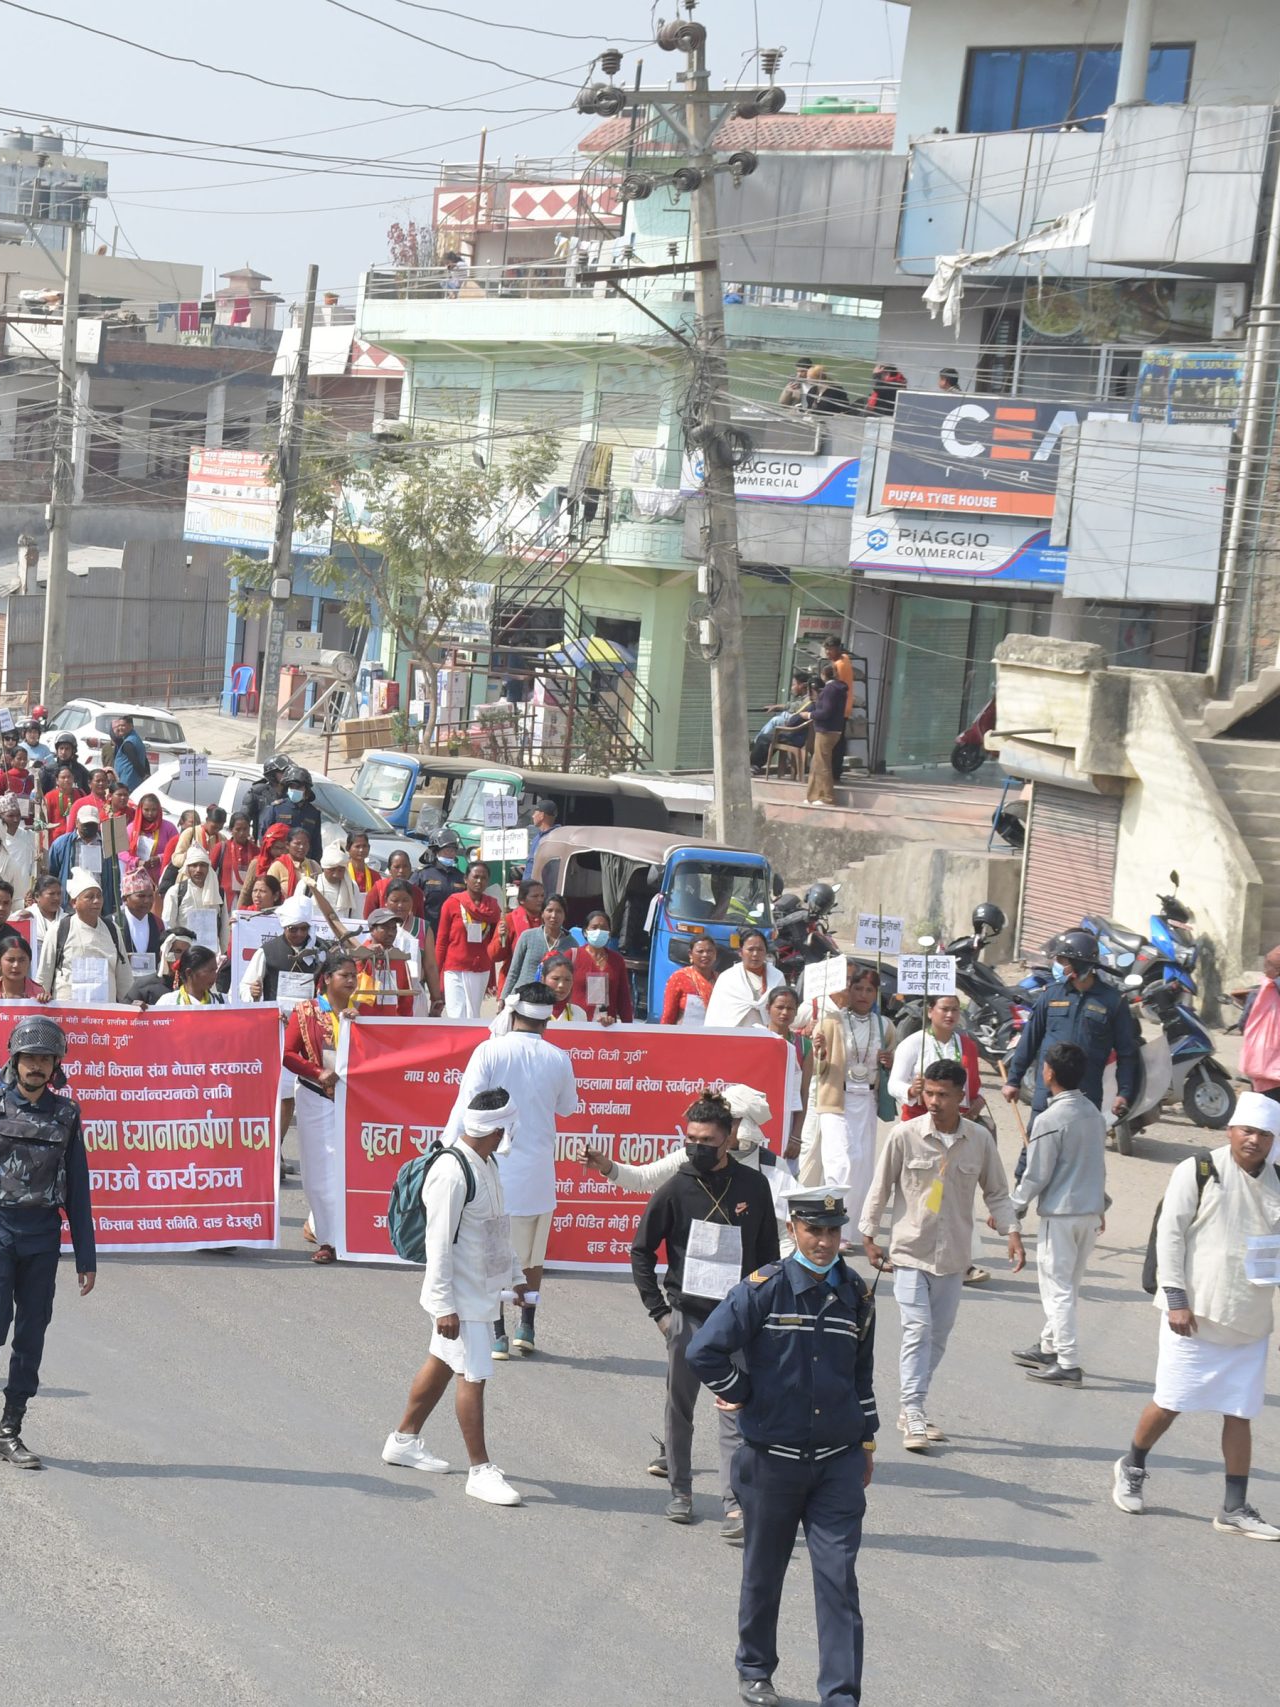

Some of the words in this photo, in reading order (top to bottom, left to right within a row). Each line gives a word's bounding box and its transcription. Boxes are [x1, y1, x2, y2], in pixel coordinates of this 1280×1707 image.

[888, 489, 924, 503] PUSPA
[927, 492, 956, 505] TYRE
[958, 494, 997, 508] HOUSE
[896, 545, 986, 561] COMMERCIAL
[0, 1012, 10, 1021] कि
[92, 1033, 110, 1045] निजी
[598, 1048, 620, 1061] निजी
[84, 1061, 105, 1077] मोही
[108, 1061, 143, 1077] किसान
[147, 1063, 168, 1078] संग
[171, 1061, 206, 1076] नेपाल
[210, 1058, 263, 1076] सरकारले
[404, 1070, 425, 1083] माघ
[427, 1071, 440, 1083] २०
[121, 1085, 199, 1101] कार्यान्वयनको
[203, 1083, 232, 1099] लागि
[636, 1076, 663, 1092] बसेका
[589, 1100, 631, 1115] समर्थनमा
[82, 1120, 118, 1152] तथा
[122, 1109, 233, 1151] ध्यानाकर्षण
[239, 1117, 271, 1151] पत्र
[360, 1122, 404, 1162] बृहत
[147, 1162, 244, 1192] कार्यक्रम
[99, 1217, 134, 1231] किसान
[137, 1217, 162, 1231] संघर्ष
[203, 1216, 223, 1228] दाङ
[226, 1213, 262, 1230] देउखुरी
[553, 1213, 573, 1232] गुठी
[576, 1214, 605, 1229] पिडित
[608, 1214, 630, 1231] मोही
[587, 1241, 607, 1255] दाङ
